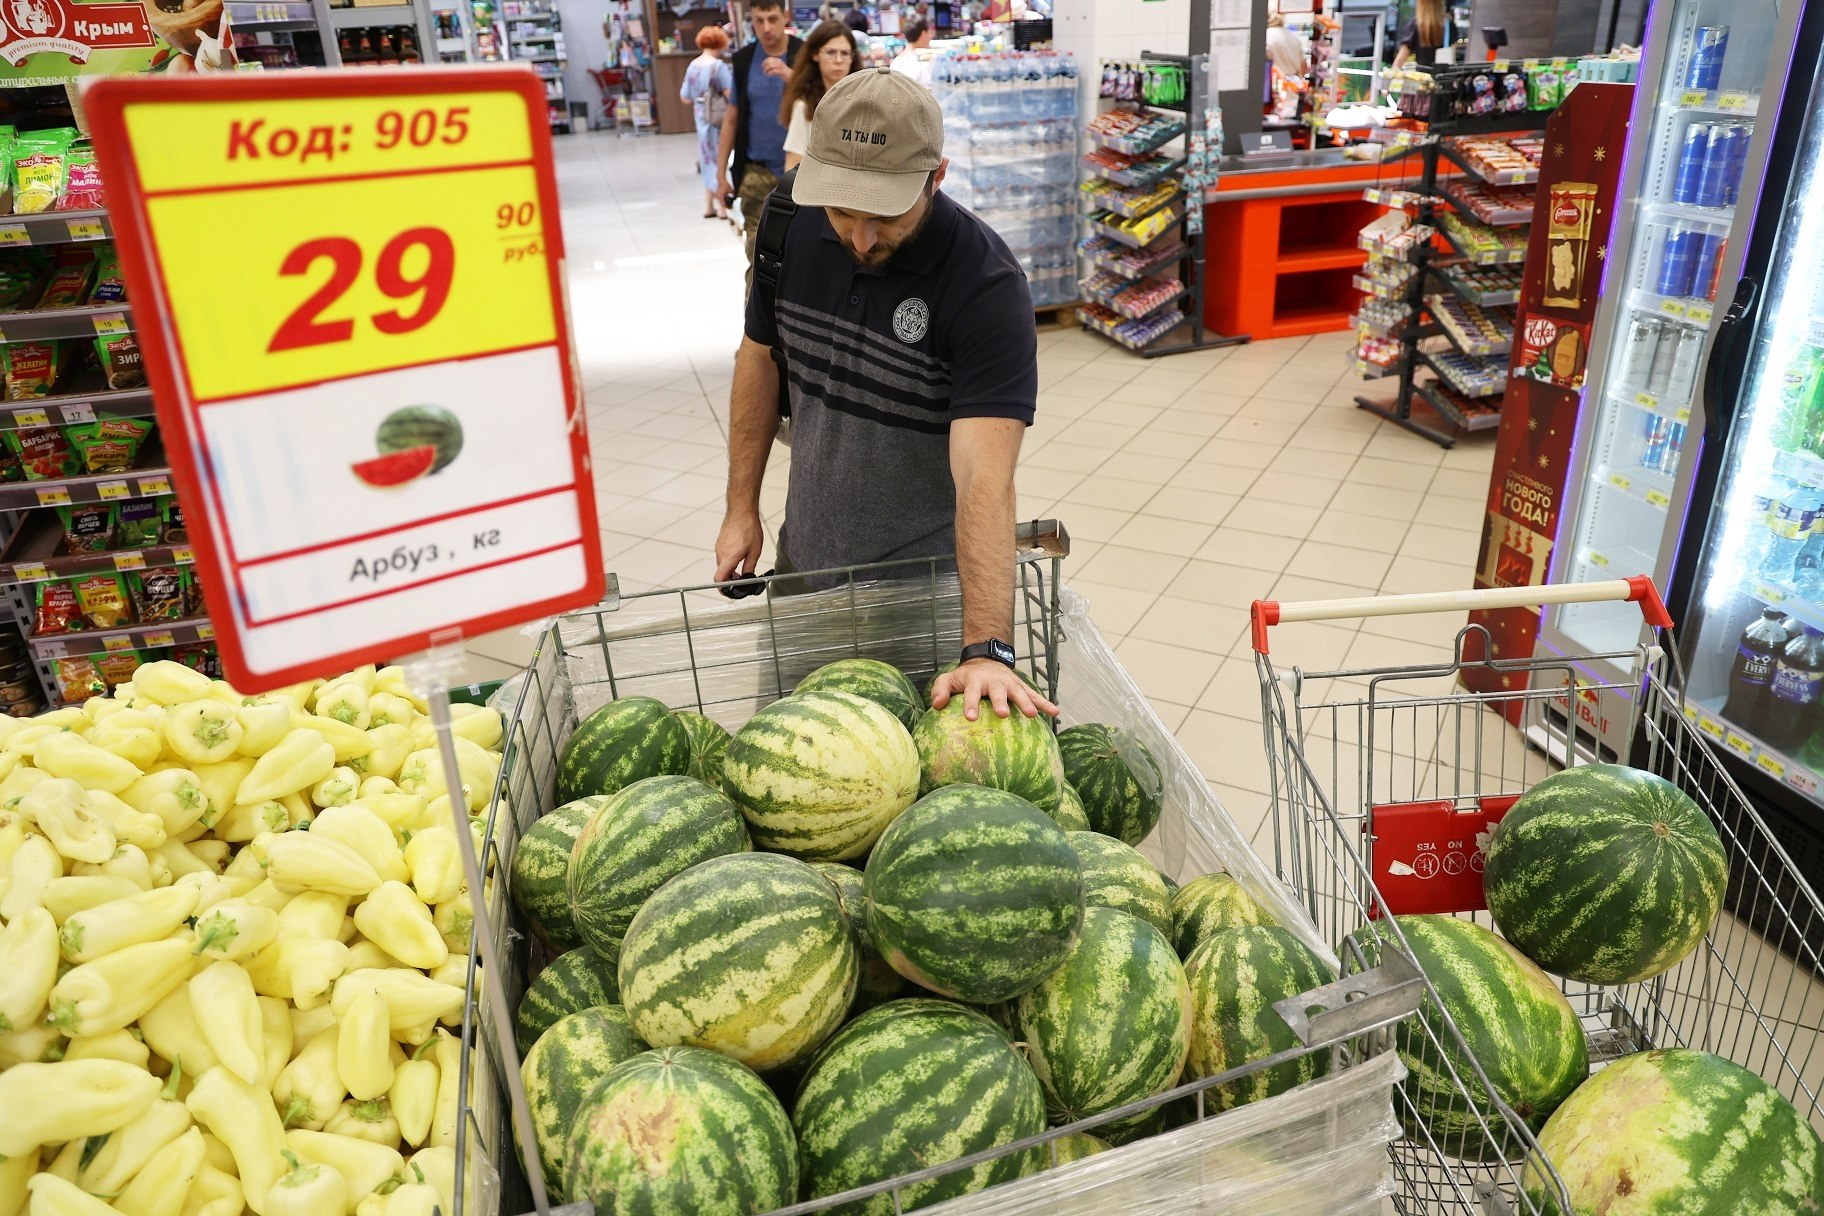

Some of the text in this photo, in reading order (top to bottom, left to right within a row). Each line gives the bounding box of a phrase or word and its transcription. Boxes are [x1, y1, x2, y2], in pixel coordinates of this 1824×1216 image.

[73, 20, 134, 40] Крым
[8, 40, 85, 58] premium quality
[226, 106, 471, 163] Код: 905
[841, 128, 887, 146] ТА ТЫ ШО
[495, 200, 535, 230] 90
[265, 225, 455, 354] 29
[1528, 320, 1556, 346] KitKat
[117, 353, 142, 365] ЗИР
[21, 431, 61, 448] БАРБАРИС
[1508, 469, 1553, 495] СЧАСТЛИВОГО
[1506, 478, 1551, 508] НОВОГО
[122, 503, 153, 513] БАЗИЛИК
[1503, 492, 1549, 527] ГОДА!
[349, 544, 439, 582] Арбуз
[473, 528, 501, 550] кг
[87, 595, 117, 607] КАРРИ
[1775, 673, 1809, 692] EVERVESS
[1416, 842, 1437, 851] YES
[1447, 840, 1463, 849] NO
